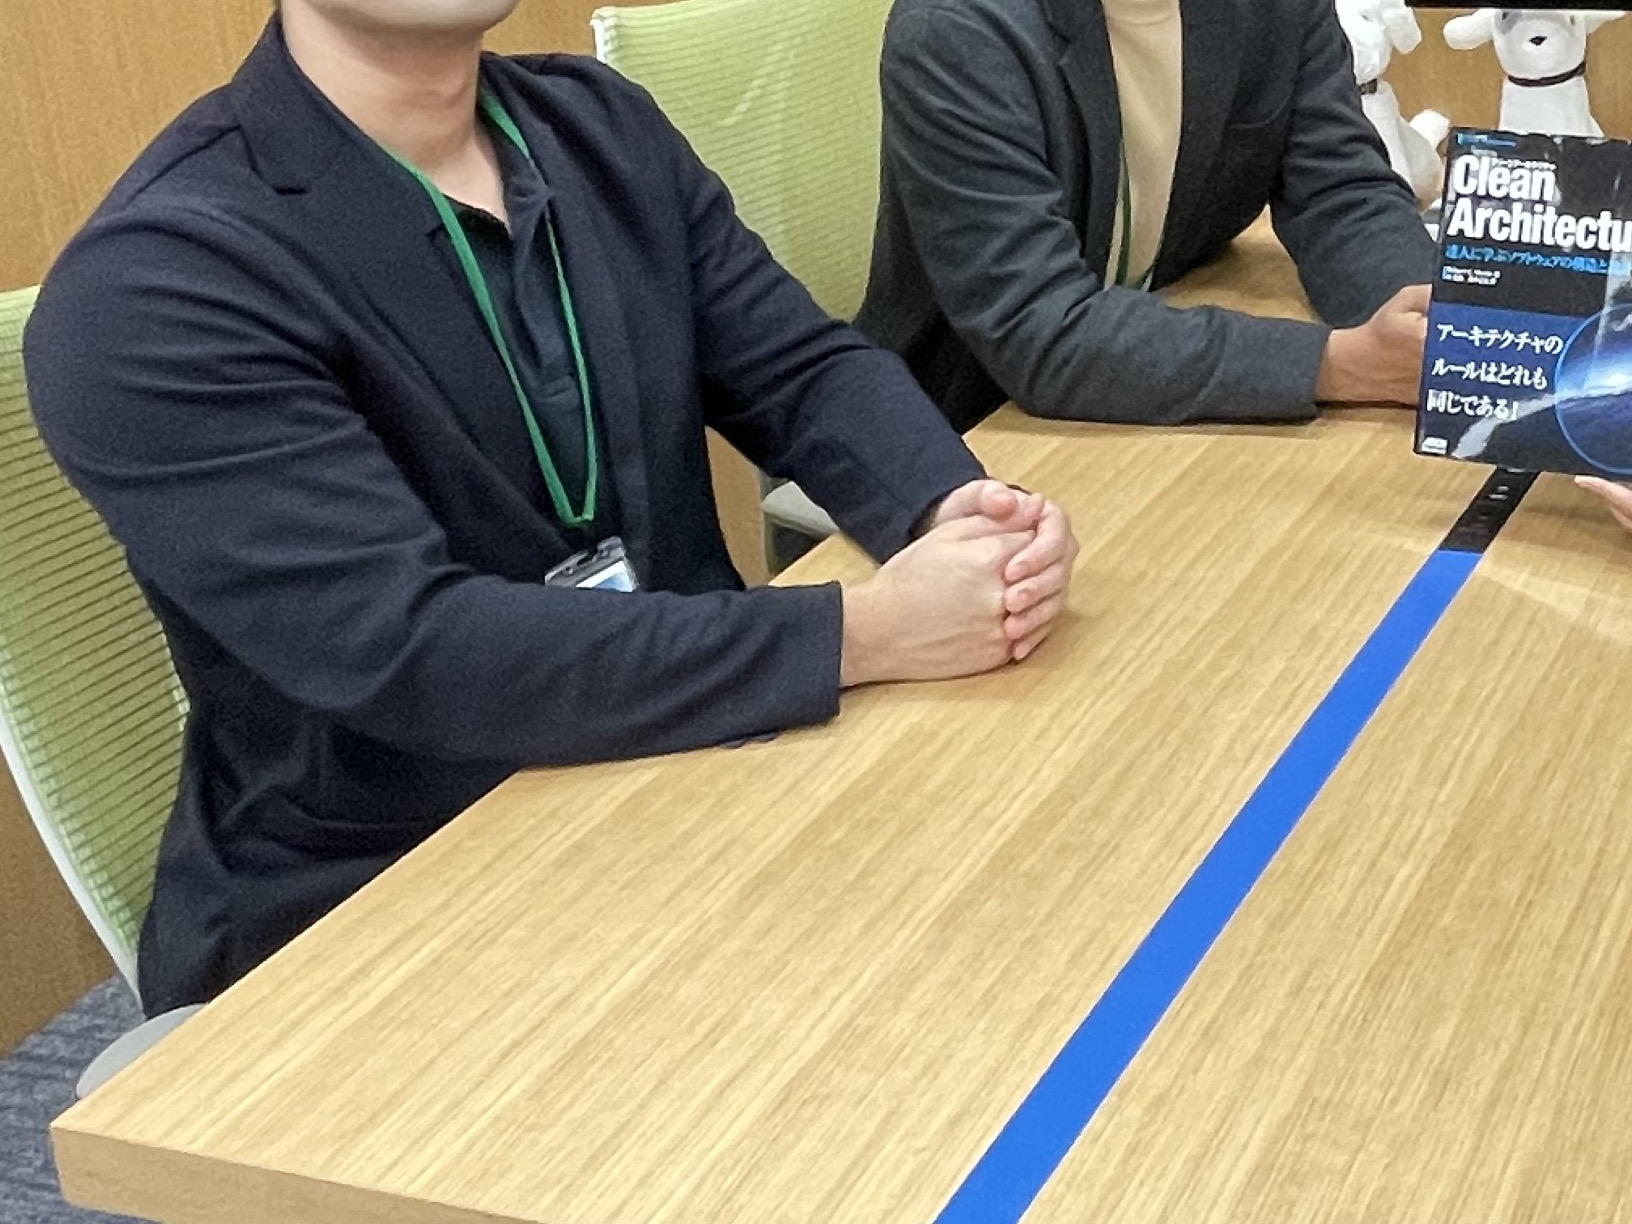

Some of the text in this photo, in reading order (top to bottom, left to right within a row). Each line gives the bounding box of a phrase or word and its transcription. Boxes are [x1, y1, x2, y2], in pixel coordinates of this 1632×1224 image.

[1452, 154, 1556, 202] Clean
[1436, 323, 1564, 355] アーキテクチャの
[1431, 357, 1549, 390] ルールはどれも
